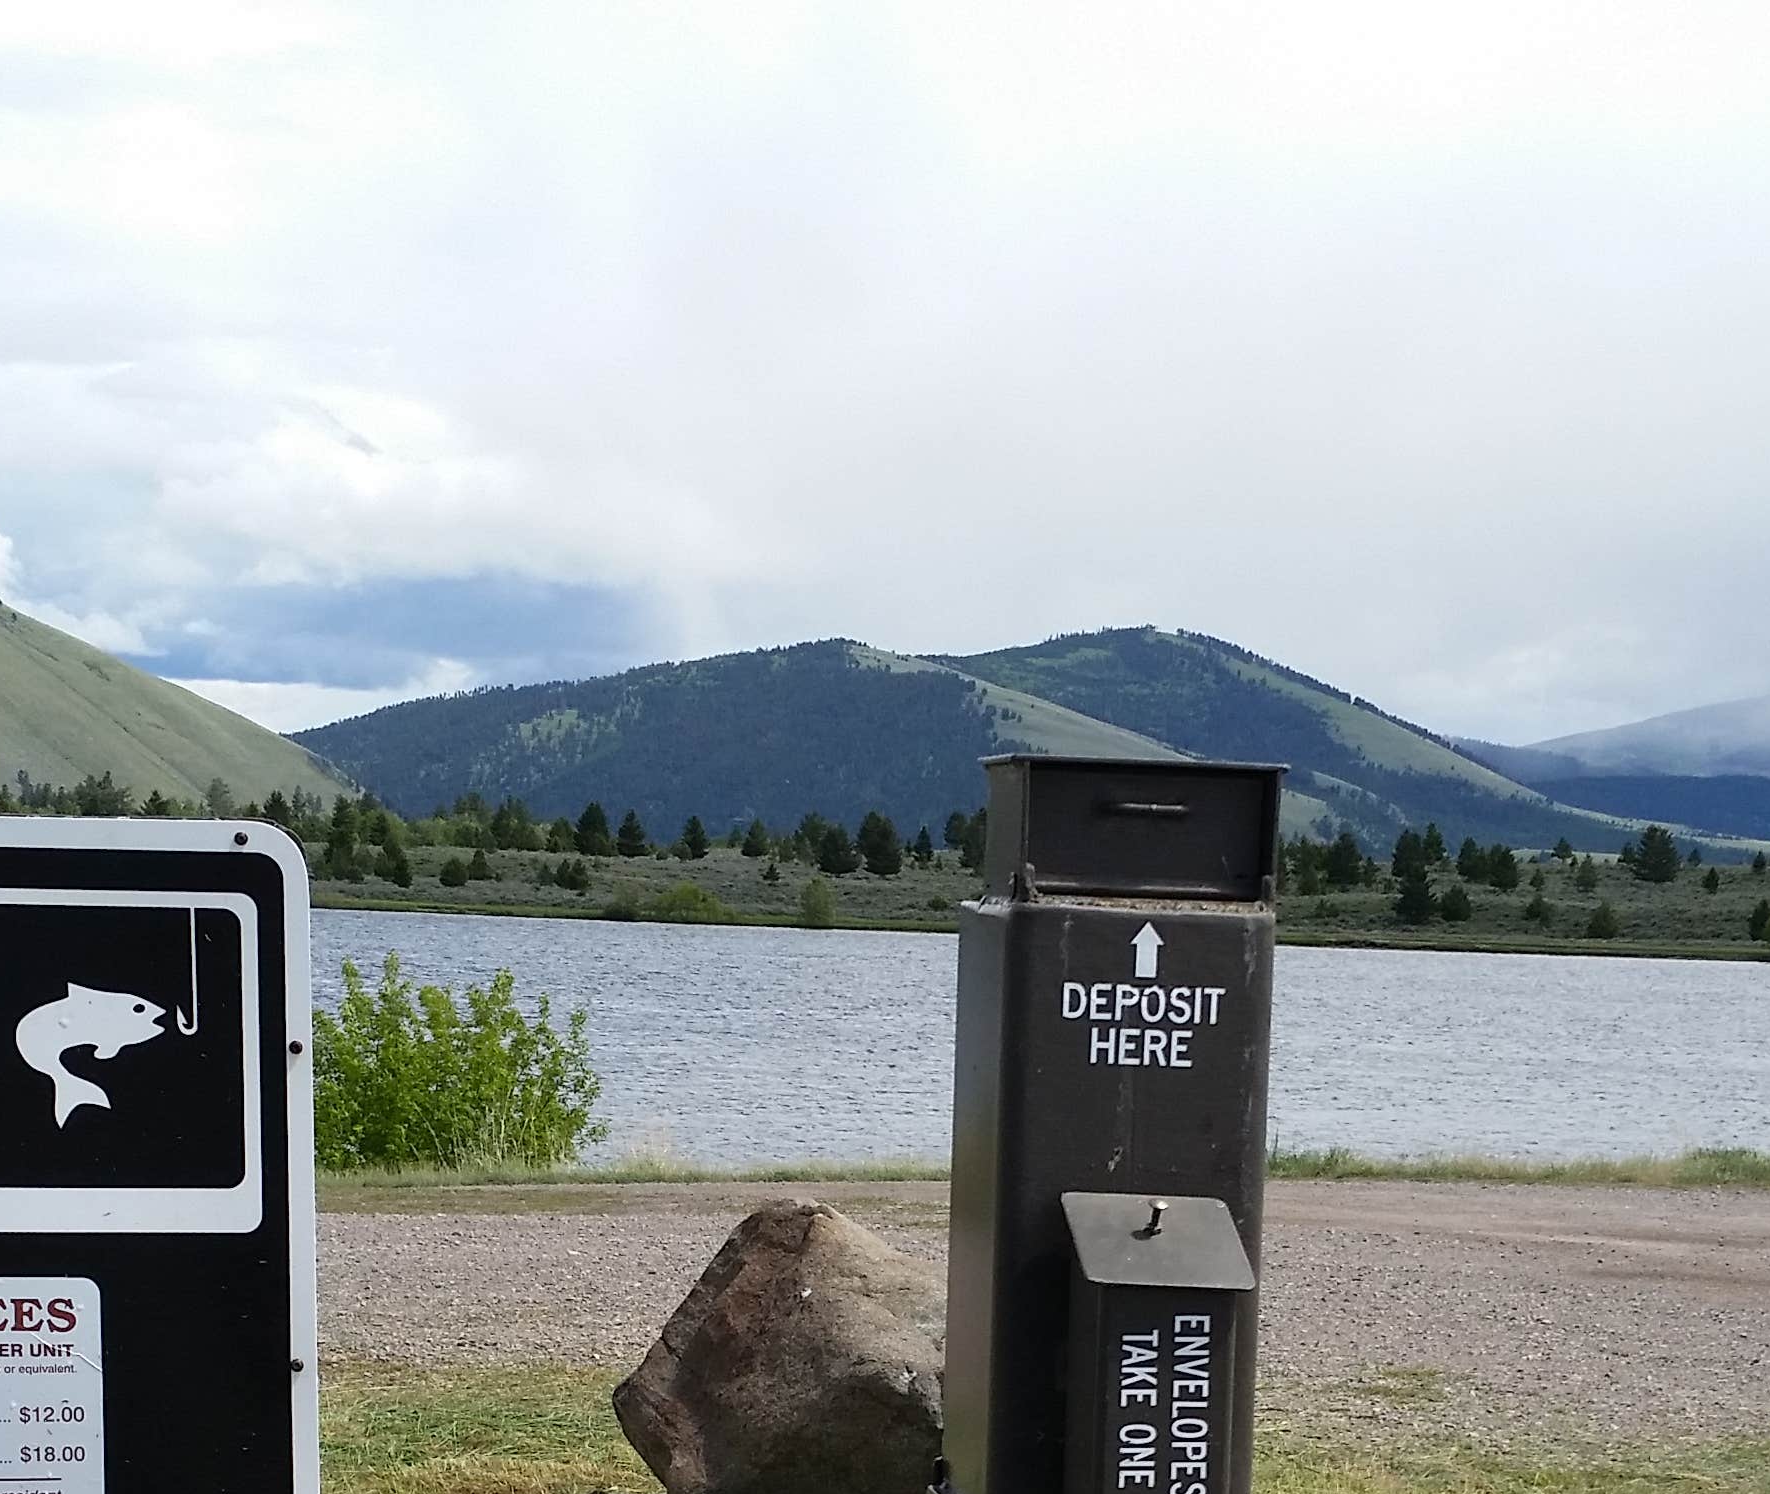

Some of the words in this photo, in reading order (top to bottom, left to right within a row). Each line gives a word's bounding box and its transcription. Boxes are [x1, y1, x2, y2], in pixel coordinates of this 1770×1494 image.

[1062, 981, 1226, 1026] DEPOSIT
[1088, 1028, 1194, 1069] HERE
[29, 1343, 76, 1358] UNIT
[3, 1366, 16, 1374] or
[18, 1363, 78, 1376] equivalent.
[1120, 1329, 1158, 1408] TAKE
[19, 1406, 85, 1425] $12.00
[20, 1444, 86, 1464] $18.00
[1117, 1423, 1157, 1489] ONE
